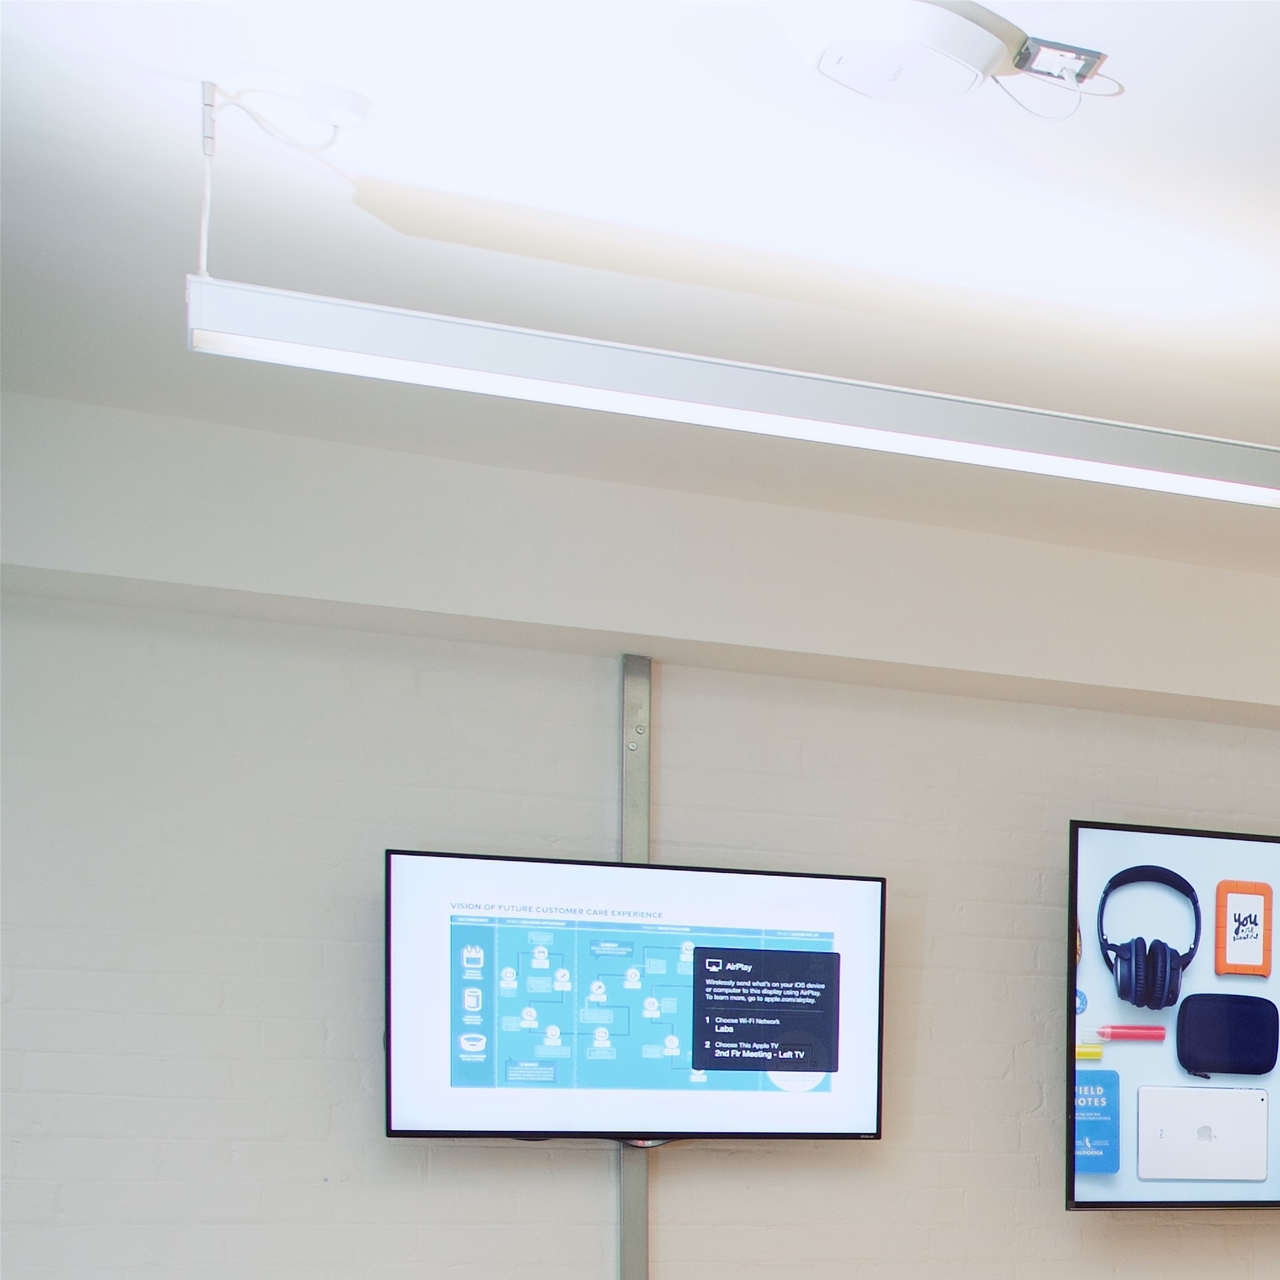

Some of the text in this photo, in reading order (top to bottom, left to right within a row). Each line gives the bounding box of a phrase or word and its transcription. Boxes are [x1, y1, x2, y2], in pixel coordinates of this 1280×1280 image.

[499, 904, 533, 913] FUTURE
[536, 906, 584, 915] CUSTOMER
[612, 910, 663, 918] EXPERIENCE
[726, 963, 752, 972] AirPlay
[705, 979, 735, 987] Wirelessly
[764, 996, 816, 1004] apple.com/airplay.
[752, 1042, 769, 1050] Apple
[742, 1050, 772, 1059] Meeting
[794, 1051, 805, 1059] TV
[1075, 1097, 1107, 1106] OTES
